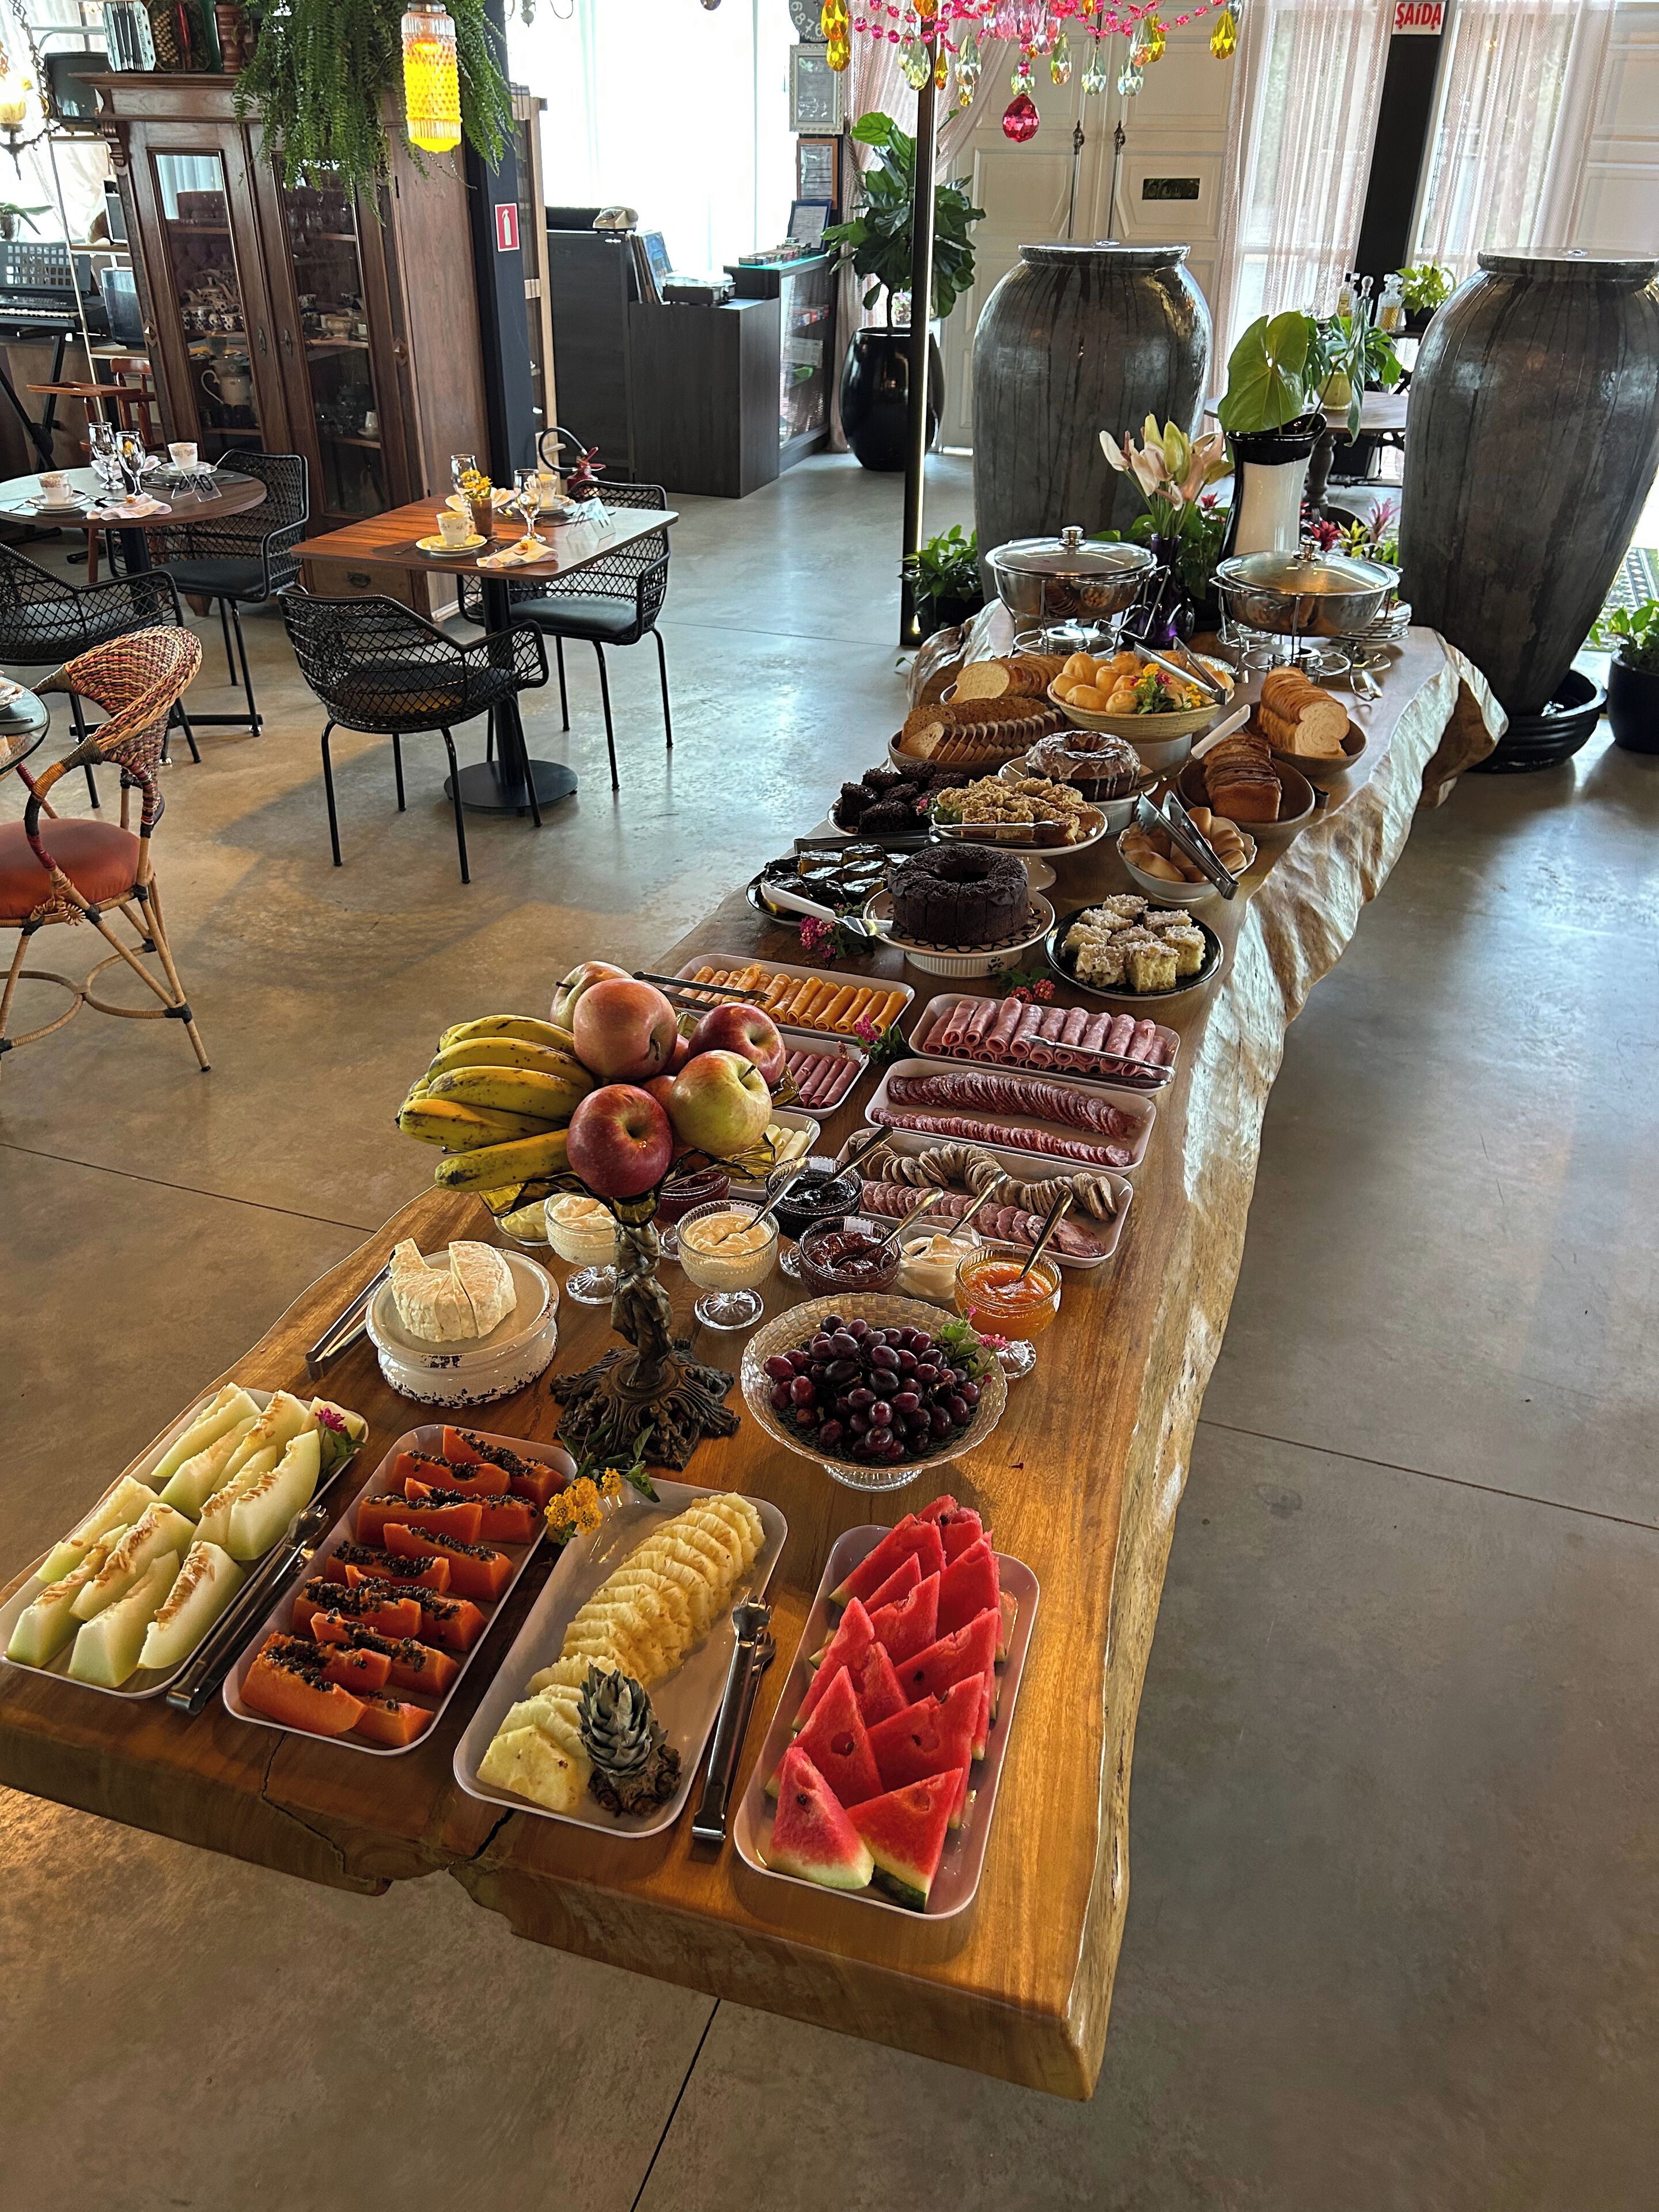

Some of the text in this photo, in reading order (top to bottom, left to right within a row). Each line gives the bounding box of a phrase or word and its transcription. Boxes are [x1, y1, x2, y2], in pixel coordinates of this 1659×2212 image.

[795, 12, 806, 25] 8
[1395, 2, 1442, 25] SAÍDA
[805, 18, 815, 33] 7
[815, 22, 823, 37] 6
